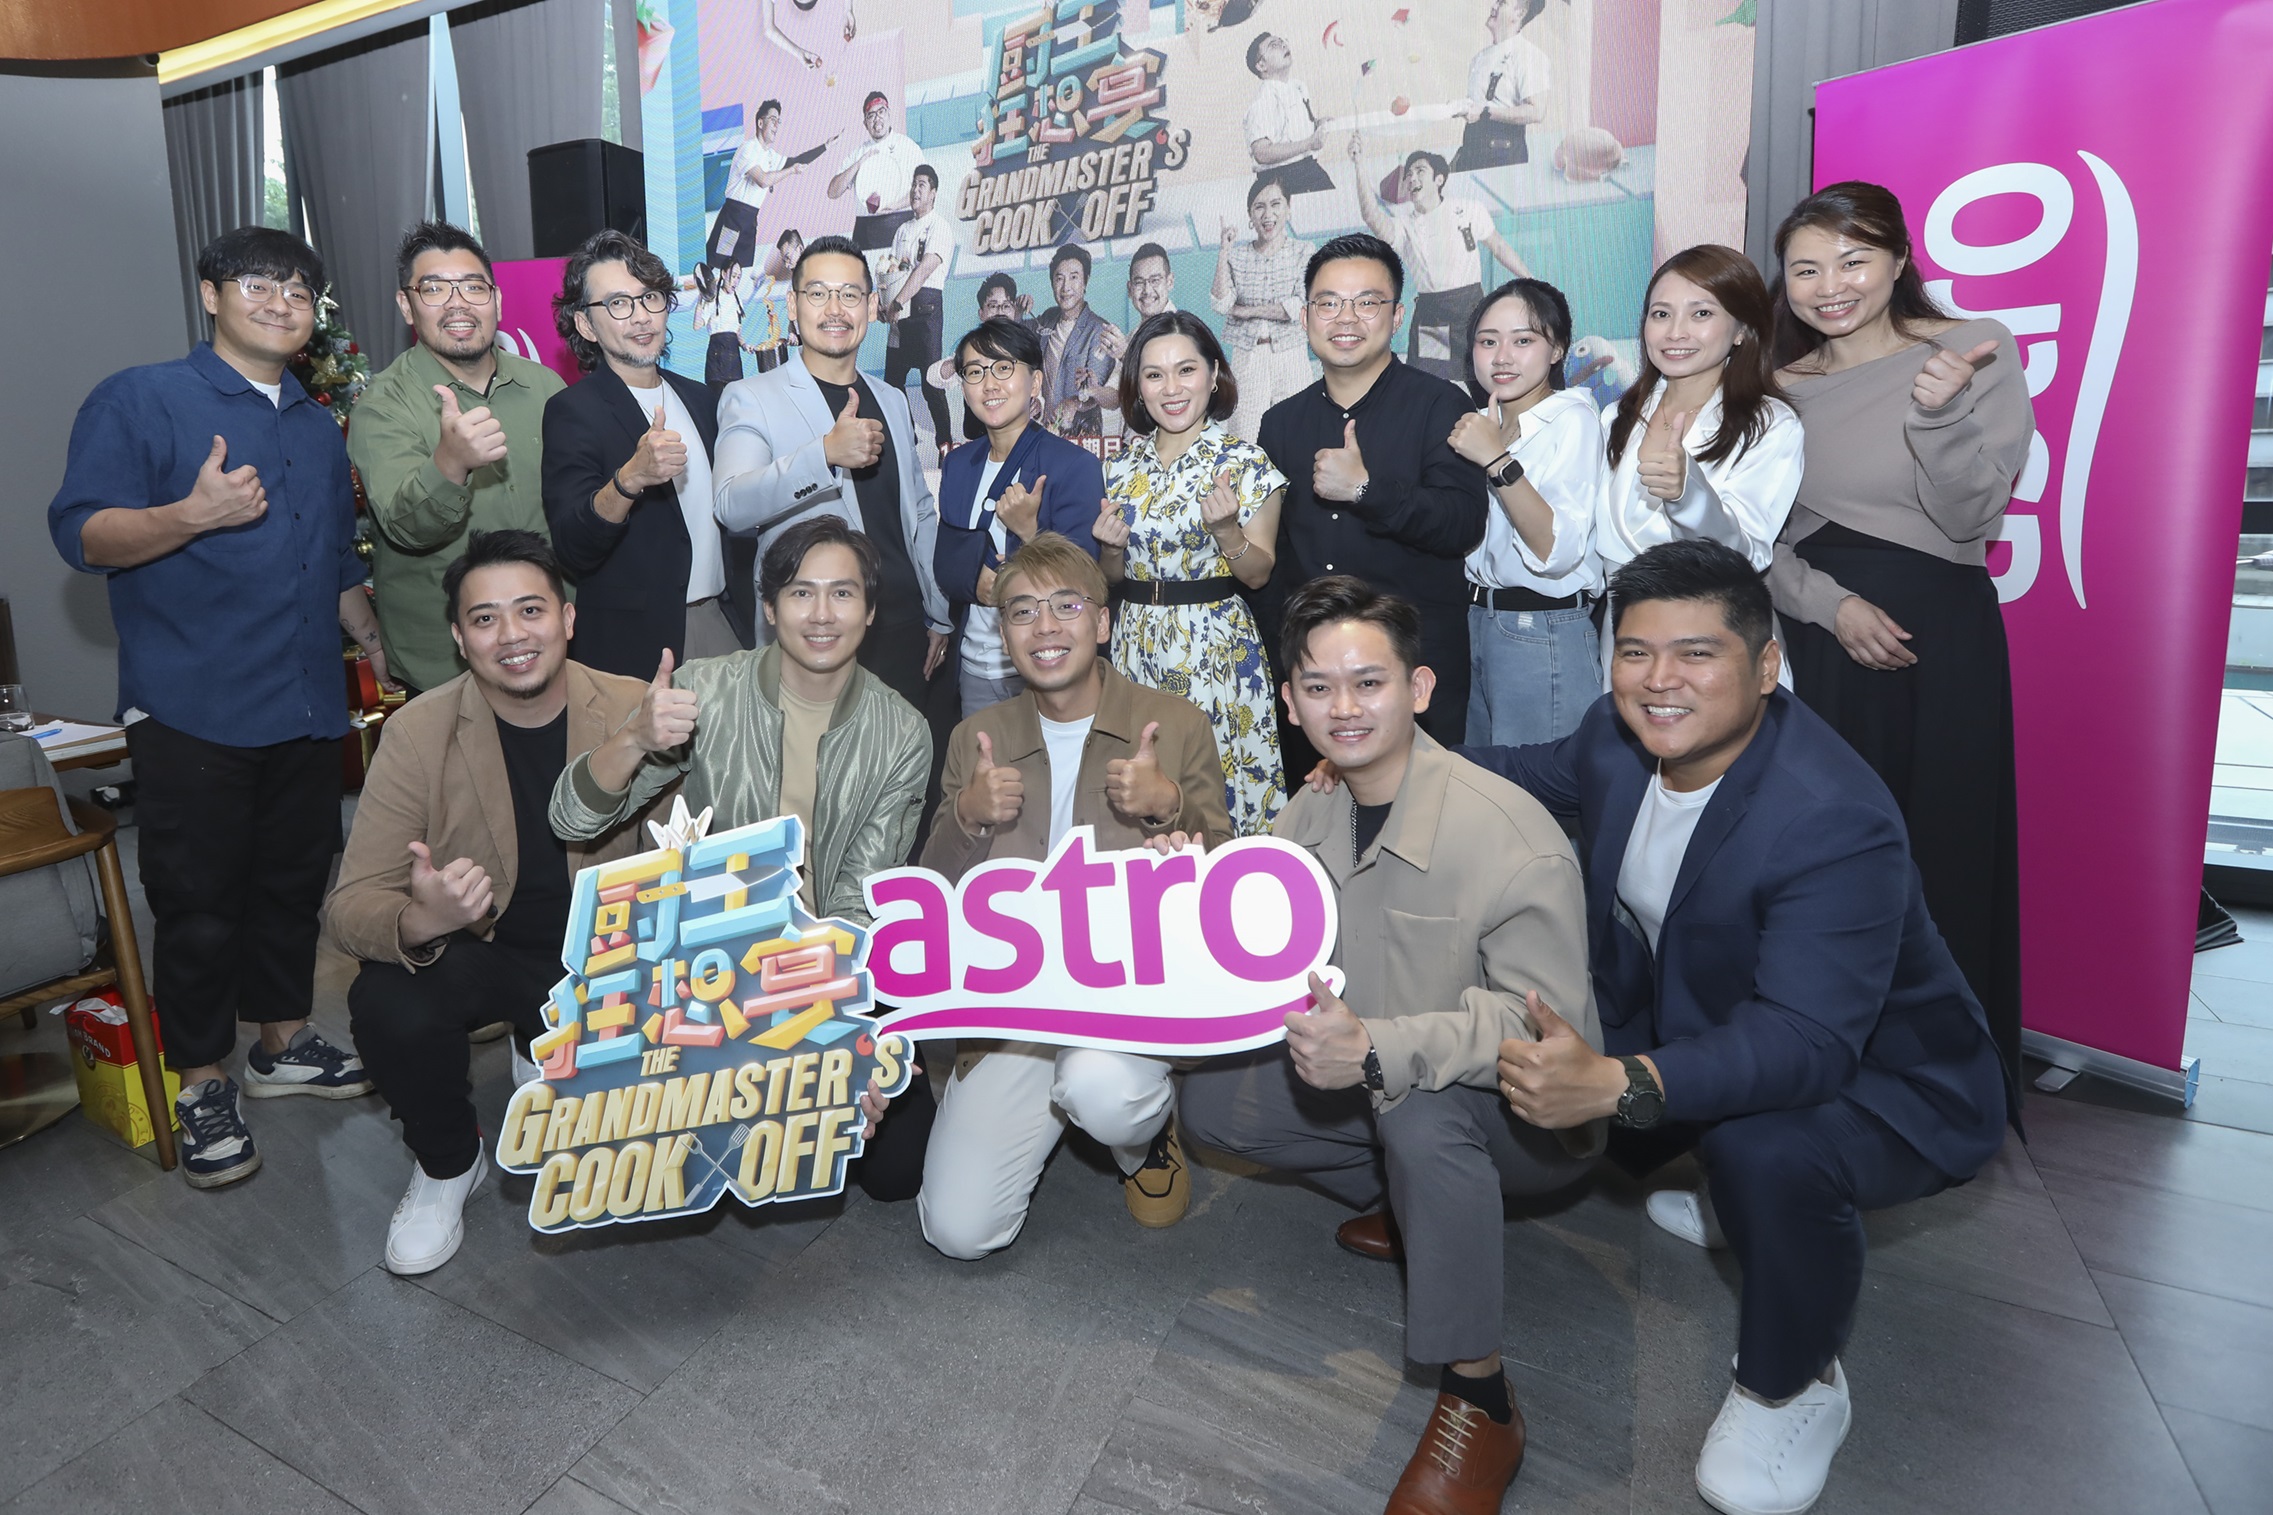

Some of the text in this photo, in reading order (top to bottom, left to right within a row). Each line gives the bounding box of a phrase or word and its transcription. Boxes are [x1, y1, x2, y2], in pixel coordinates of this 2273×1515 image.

[989, 0, 1122, 99] 厨王
[959, 129, 1189, 220] GRANDMASTER'S
[1027, 142, 1050, 163] THE
[974, 180, 1153, 255] COOK OFF
[564, 819, 792, 976] 厨王
[869, 836, 1326, 998] astro
[533, 925, 861, 1079] 狂想宴
[503, 1033, 904, 1167] GRANDMASTER'S
[641, 1046, 681, 1077] THE
[532, 1106, 856, 1228] COOK OFF
